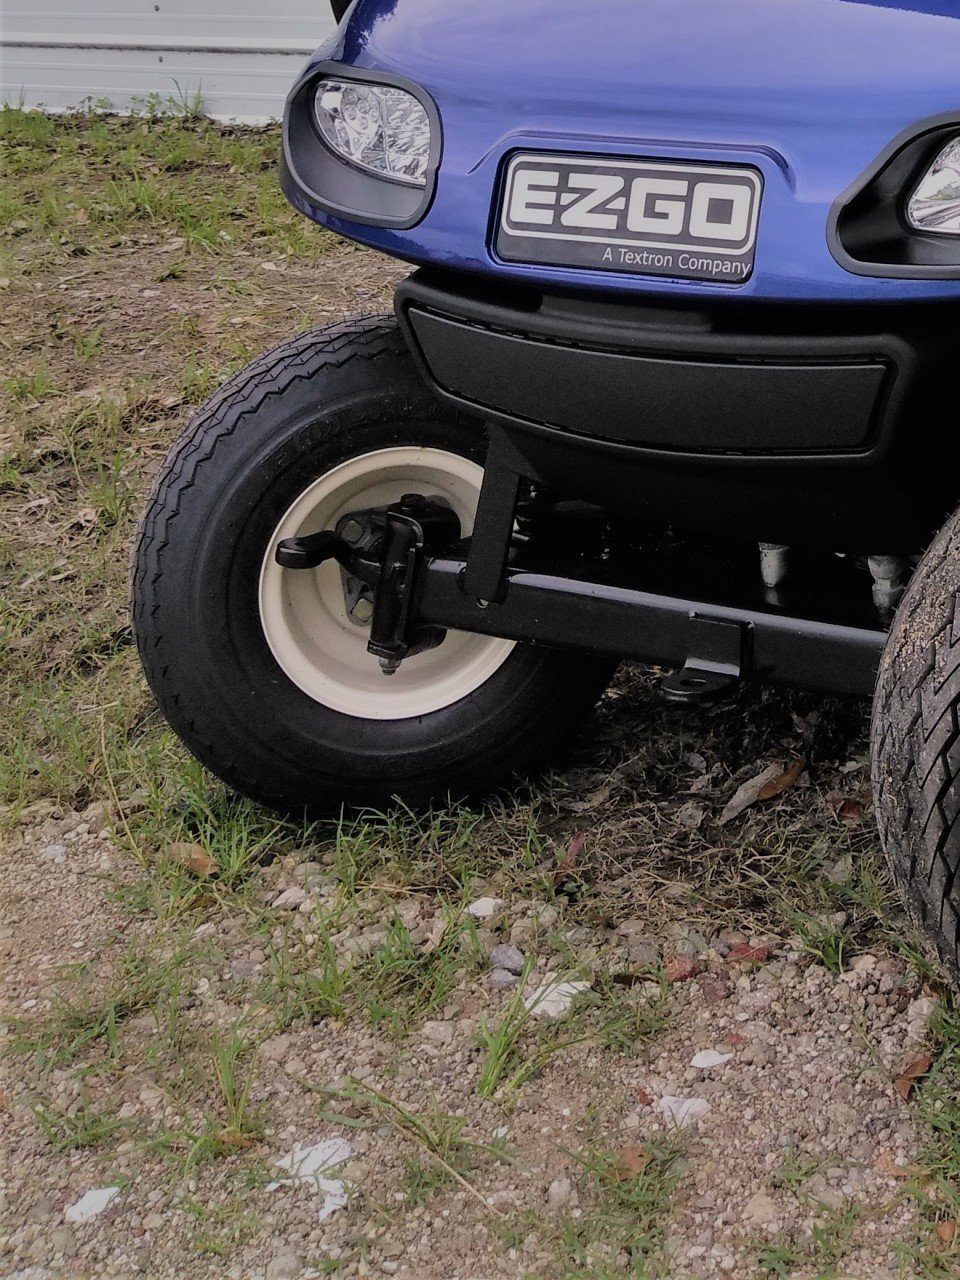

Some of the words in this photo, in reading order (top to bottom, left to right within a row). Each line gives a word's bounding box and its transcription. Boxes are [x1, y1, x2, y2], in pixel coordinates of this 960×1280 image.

[602, 247, 614, 262] A
[618, 248, 673, 268] Textron
[678, 253, 752, 278] Company
